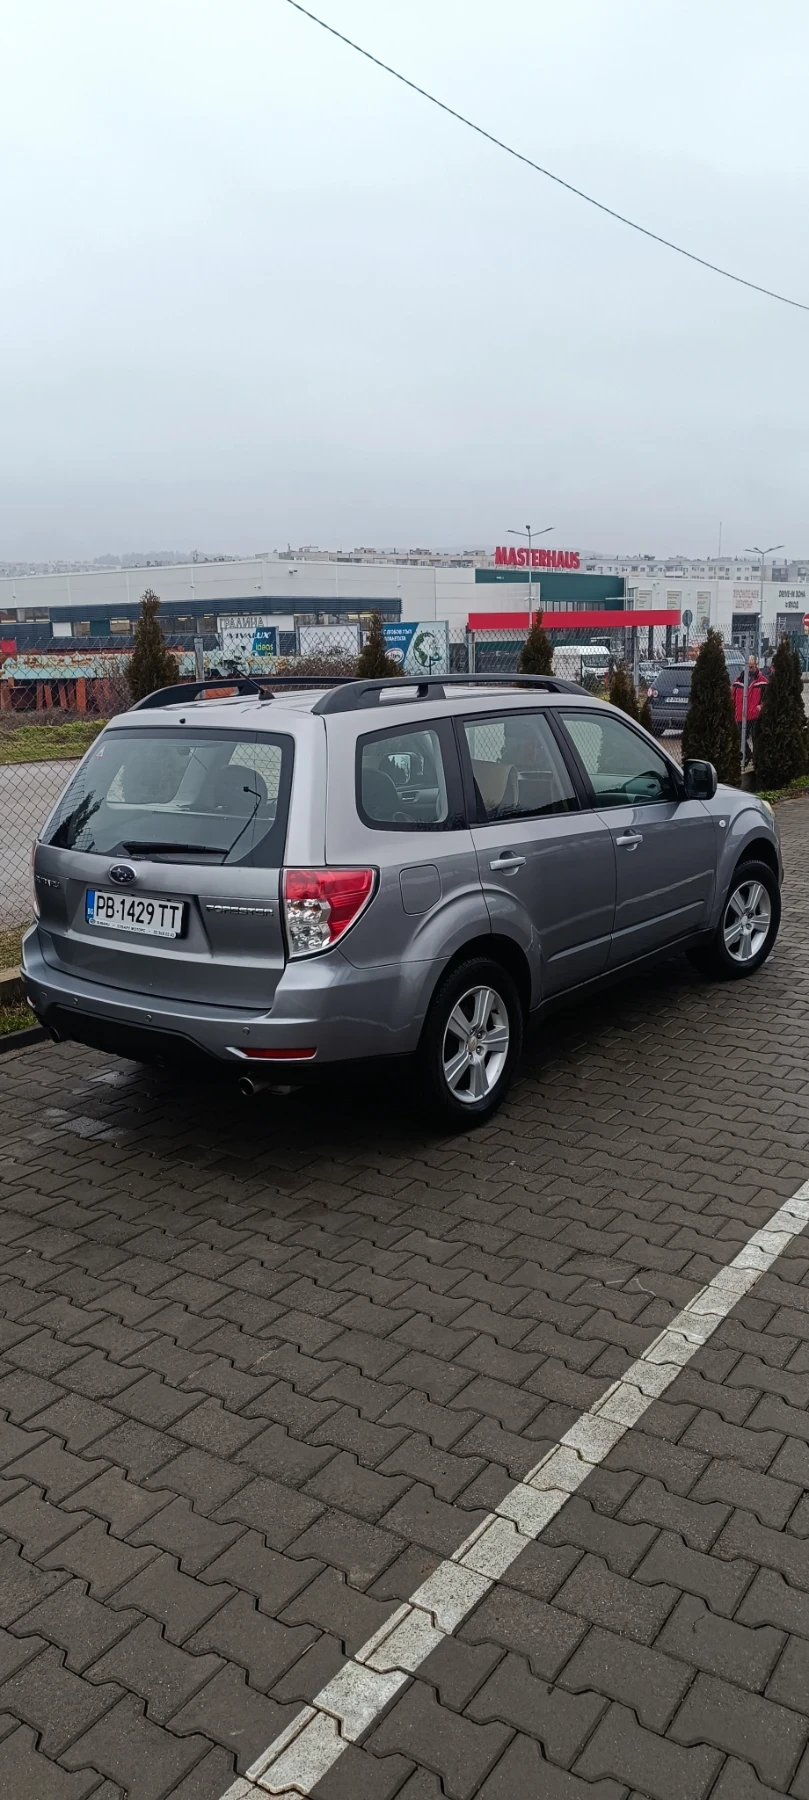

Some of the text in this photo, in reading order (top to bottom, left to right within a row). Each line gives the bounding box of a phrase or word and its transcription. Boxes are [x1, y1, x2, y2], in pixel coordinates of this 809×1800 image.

[495, 546, 580, 569] MASTERHAUS
[158, 903, 180, 929] TT
[206, 904, 274, 916] FORESTER
